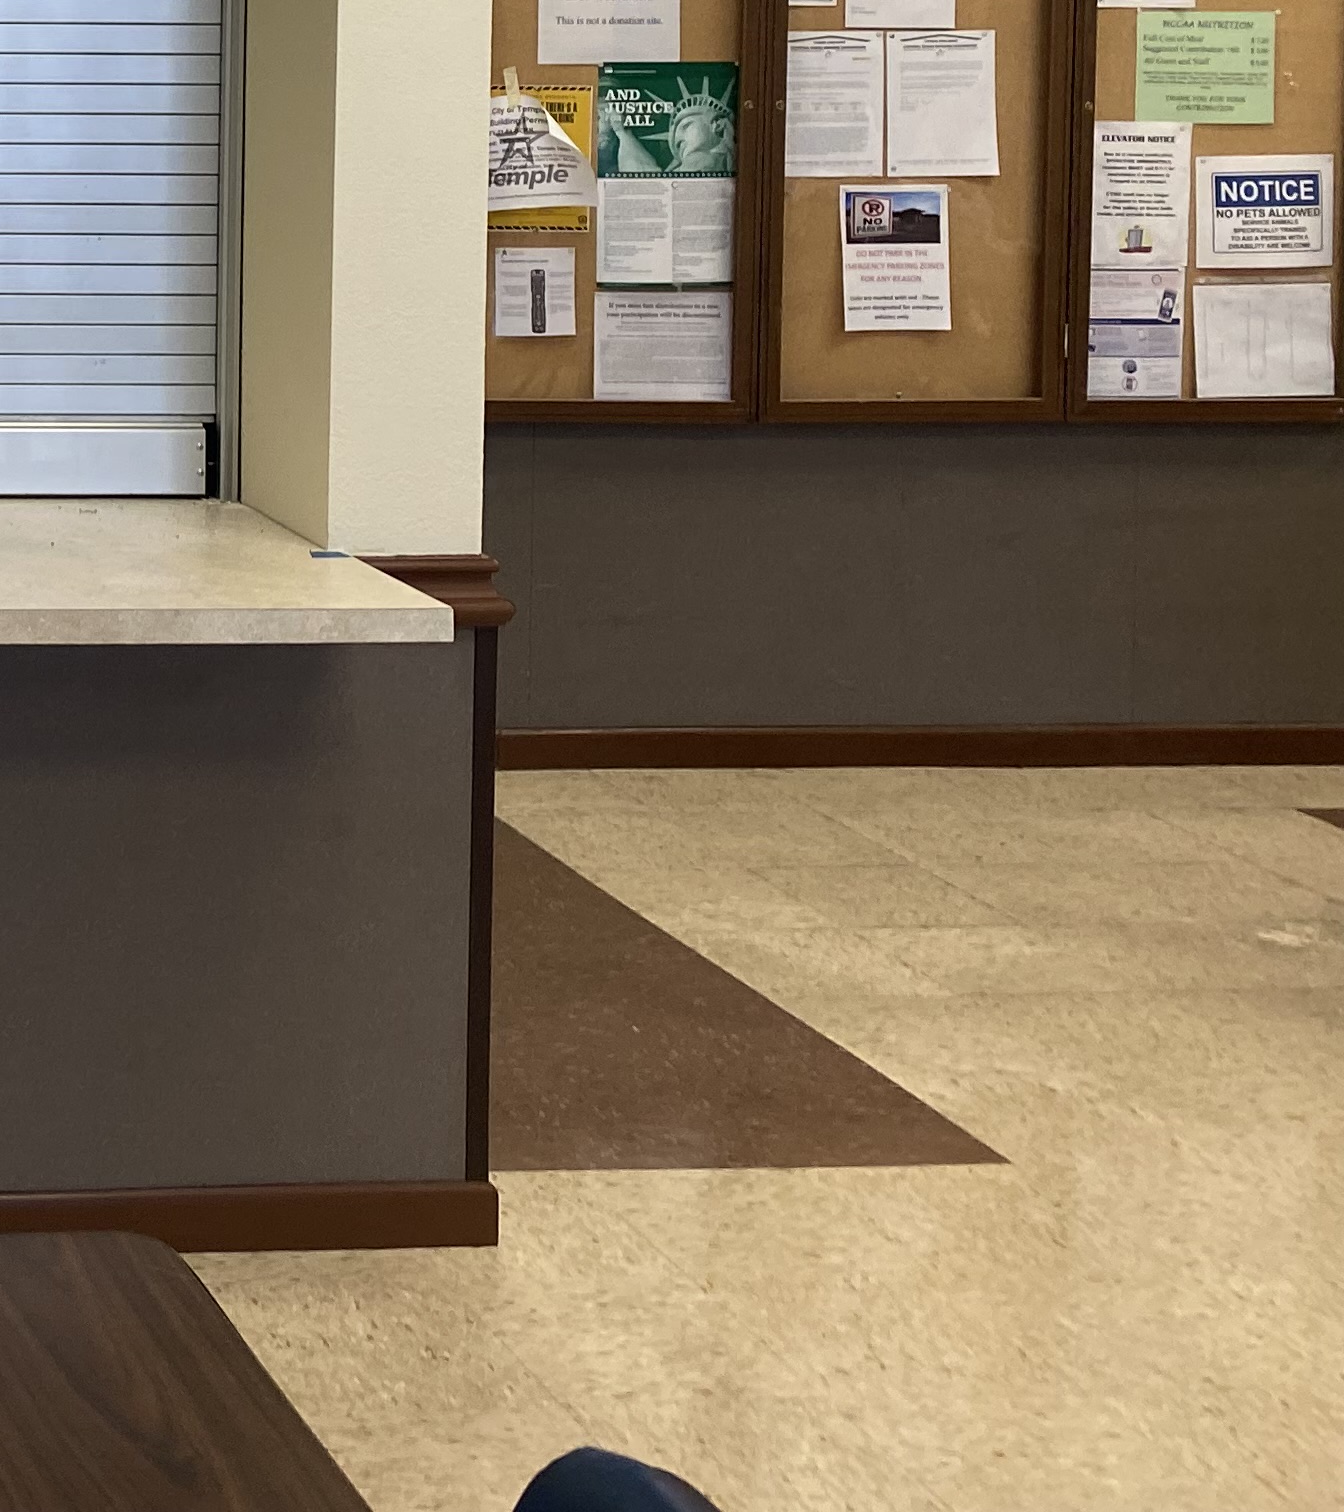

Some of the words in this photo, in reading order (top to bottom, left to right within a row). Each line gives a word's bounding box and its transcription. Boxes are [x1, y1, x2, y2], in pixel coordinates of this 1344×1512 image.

[556, 16, 574, 24] This
[577, 16, 583, 24] is
[605, 89, 640, 100] AND
[605, 102, 673, 113] JUSTICE
[624, 115, 654, 126] ALL
[1220, 180, 1315, 202] NOTICE
[1216, 210, 1232, 218] NO
[1237, 209, 1265, 218] PETS
[1268, 208, 1320, 217] ALLOWED
[856, 225, 887, 233] PARKING
[845, 262, 885, 270] EMERGENCY
